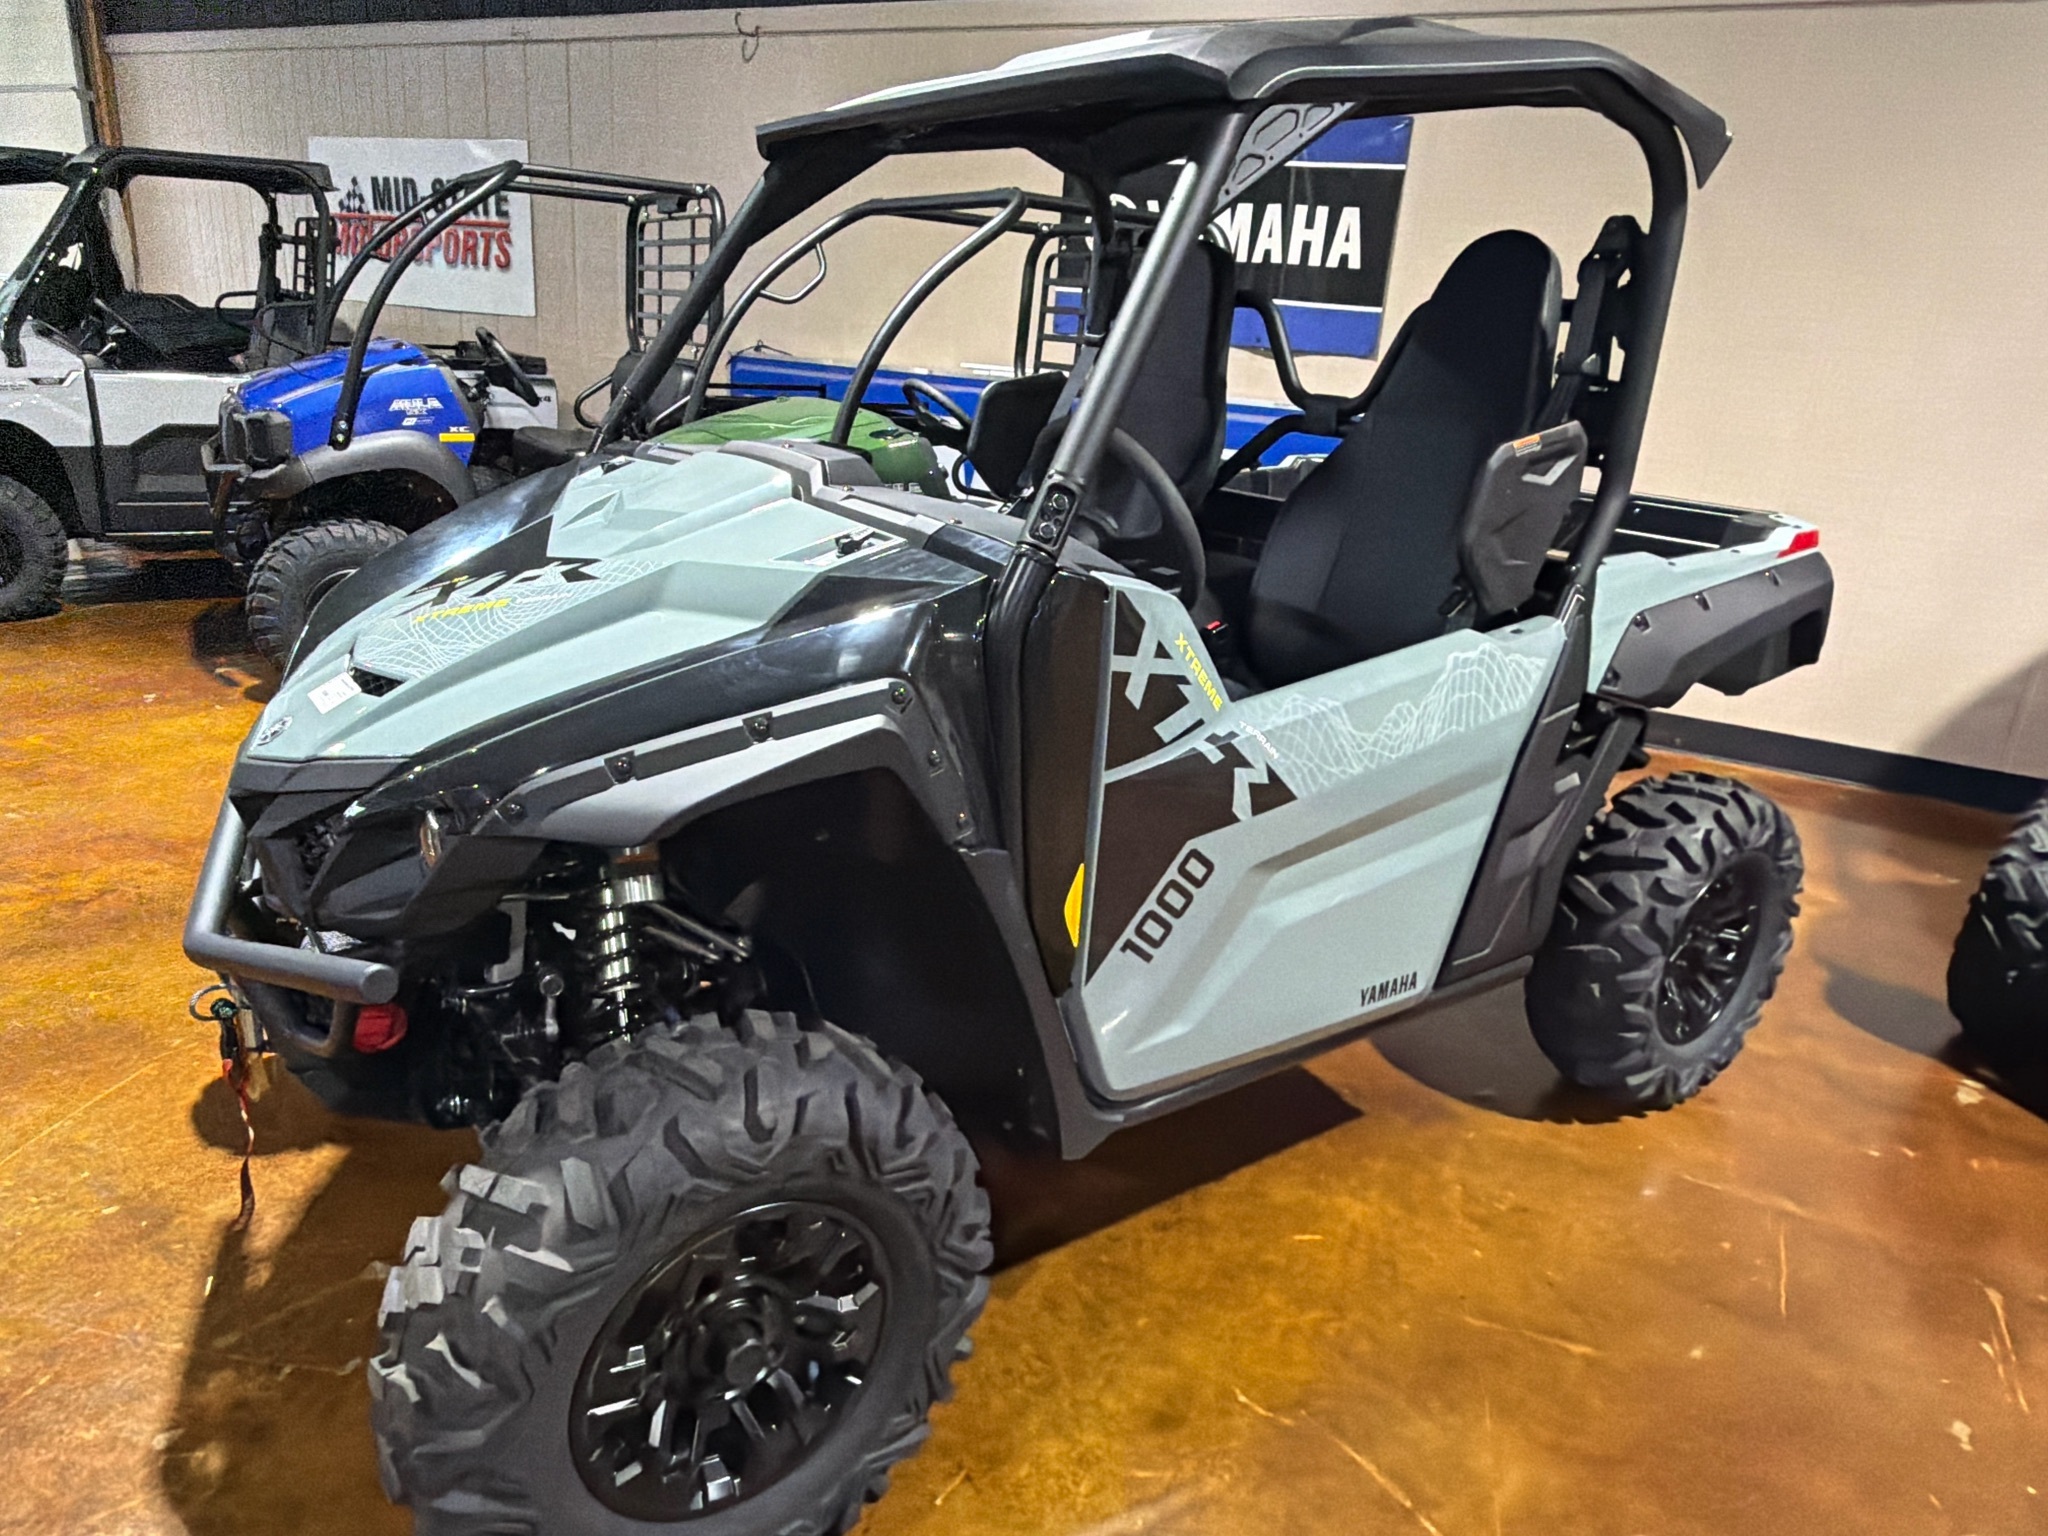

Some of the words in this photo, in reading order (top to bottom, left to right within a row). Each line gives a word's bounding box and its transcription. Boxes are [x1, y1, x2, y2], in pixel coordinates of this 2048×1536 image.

[371, 176, 509, 217] MID-SE
[1147, 200, 1362, 269] MAHA
[1175, 632, 1223, 712] XTREME
[1239, 720, 1279, 760] TERRAIN
[1120, 848, 1214, 963] 1000
[1360, 971, 1417, 1007] YAMAHA
